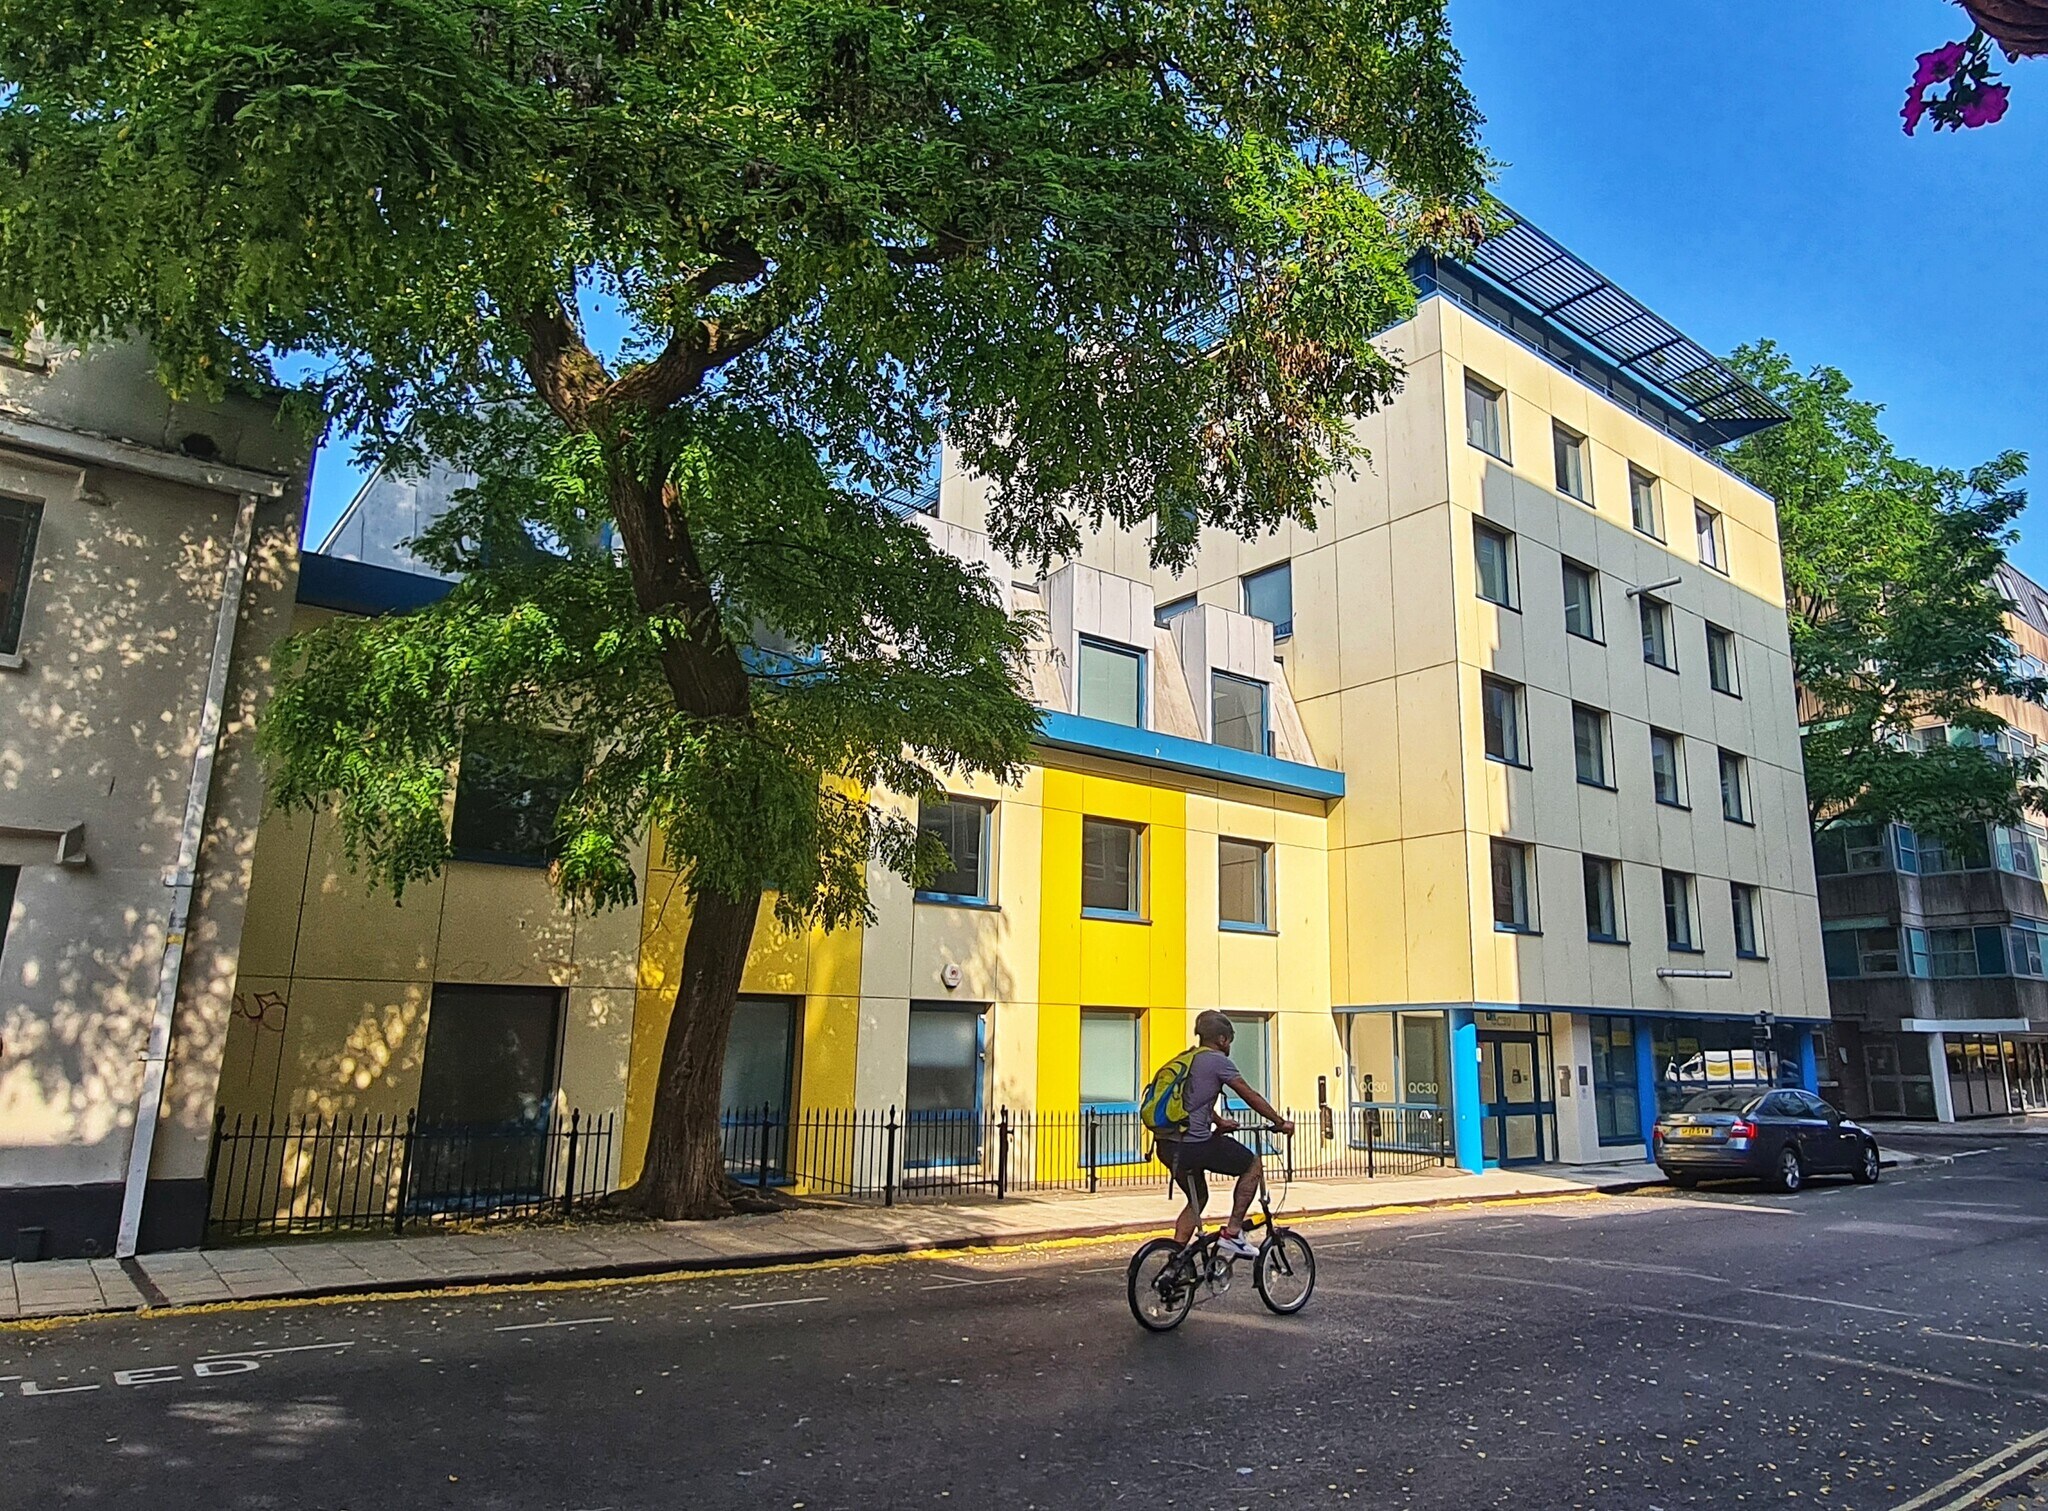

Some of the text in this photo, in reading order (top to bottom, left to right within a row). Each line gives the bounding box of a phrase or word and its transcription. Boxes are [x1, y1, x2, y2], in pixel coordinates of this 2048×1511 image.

[1360, 1081, 1388, 1093] QC30
[1408, 1082, 1438, 1094] QC30
[0, 1360, 260, 1398] LED
